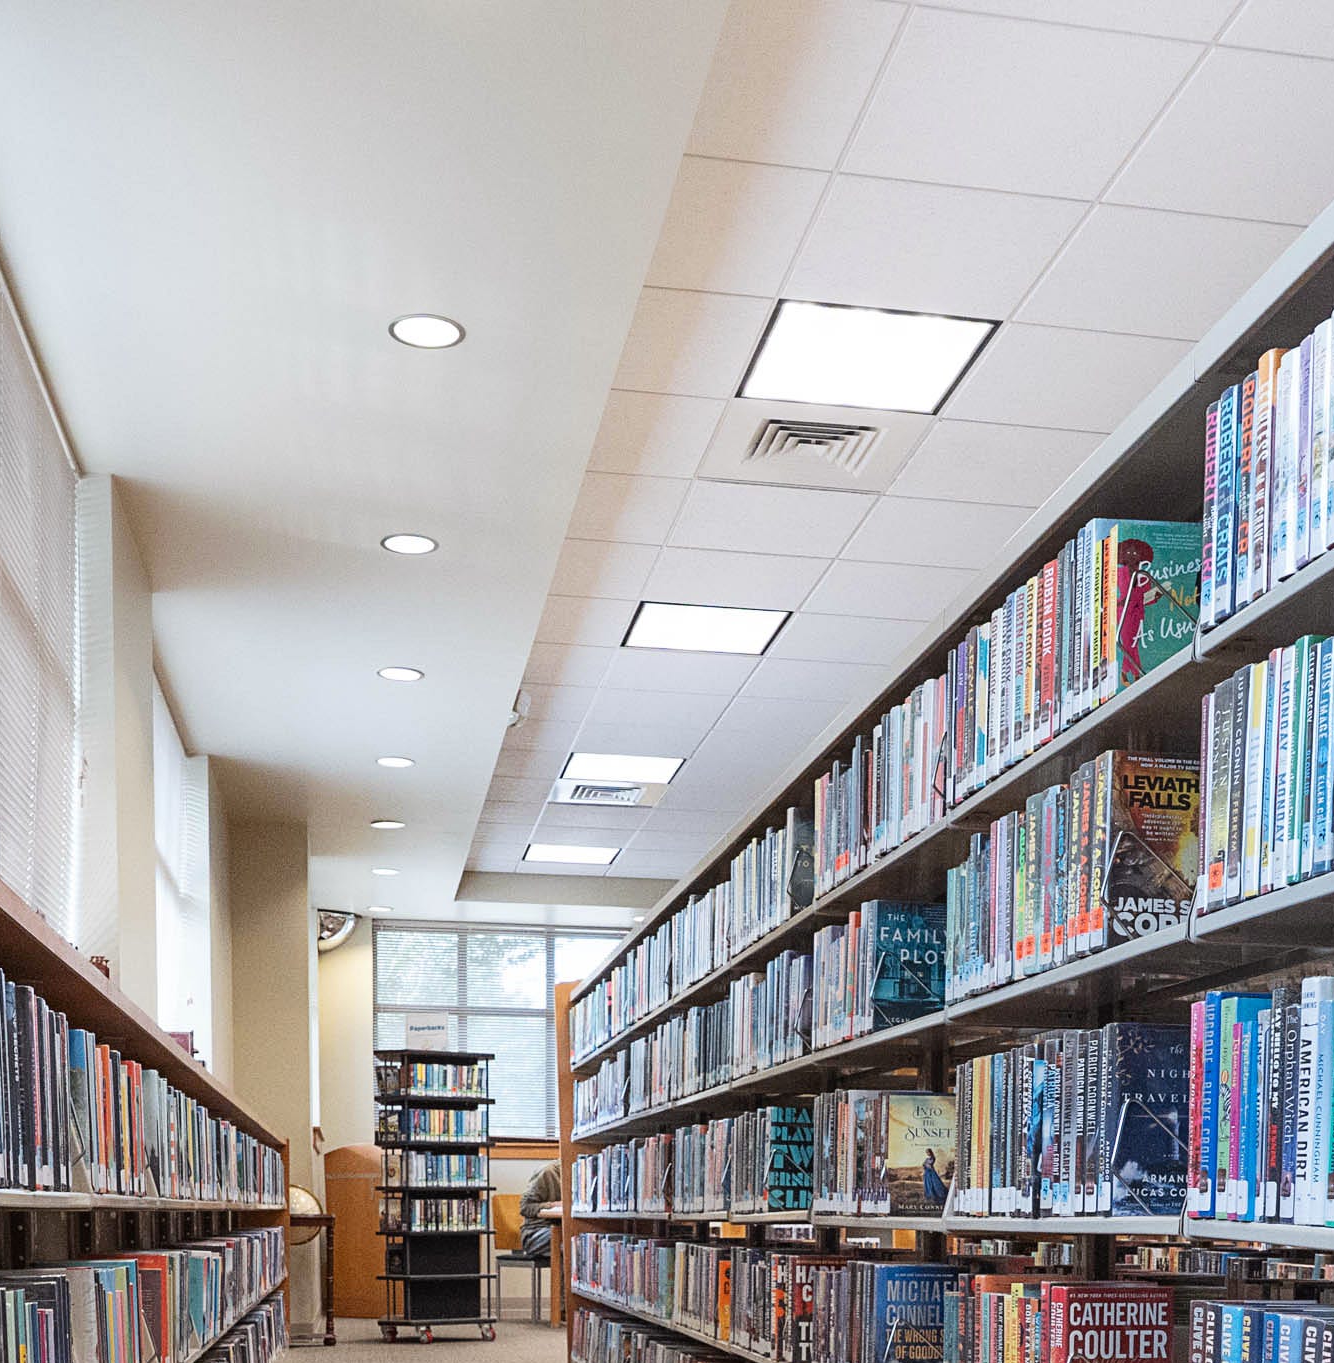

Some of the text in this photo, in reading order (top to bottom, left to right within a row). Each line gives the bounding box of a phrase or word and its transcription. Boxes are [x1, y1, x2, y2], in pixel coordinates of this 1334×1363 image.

[1240, 378, 1255, 475] ROBERT
[1215, 394, 1236, 588] ROBERT CRAIS
[1042, 567, 1054, 656] ROBIN COOK
[1131, 620, 1154, 648] As
[1281, 680, 1290, 751] MONDAY
[1233, 674, 1245, 786] JUSTIN CRONIN
[1128, 791, 1191, 812] FALLS
[887, 913, 905, 922] THE
[1113, 898, 1176, 914] JAMES
[900, 948, 948, 965] PLOT
[914, 1106, 943, 1118] INTO
[1295, 1039, 1312, 1181] AMERICAN DIRT
[904, 1127, 952, 1140] SUNSET
[1069, 1302, 1168, 1326] CATHERINE
[905, 1329, 938, 1343] WRONG
[1069, 1330, 1167, 1360] COULTER
[895, 1347, 907, 1359] OF
